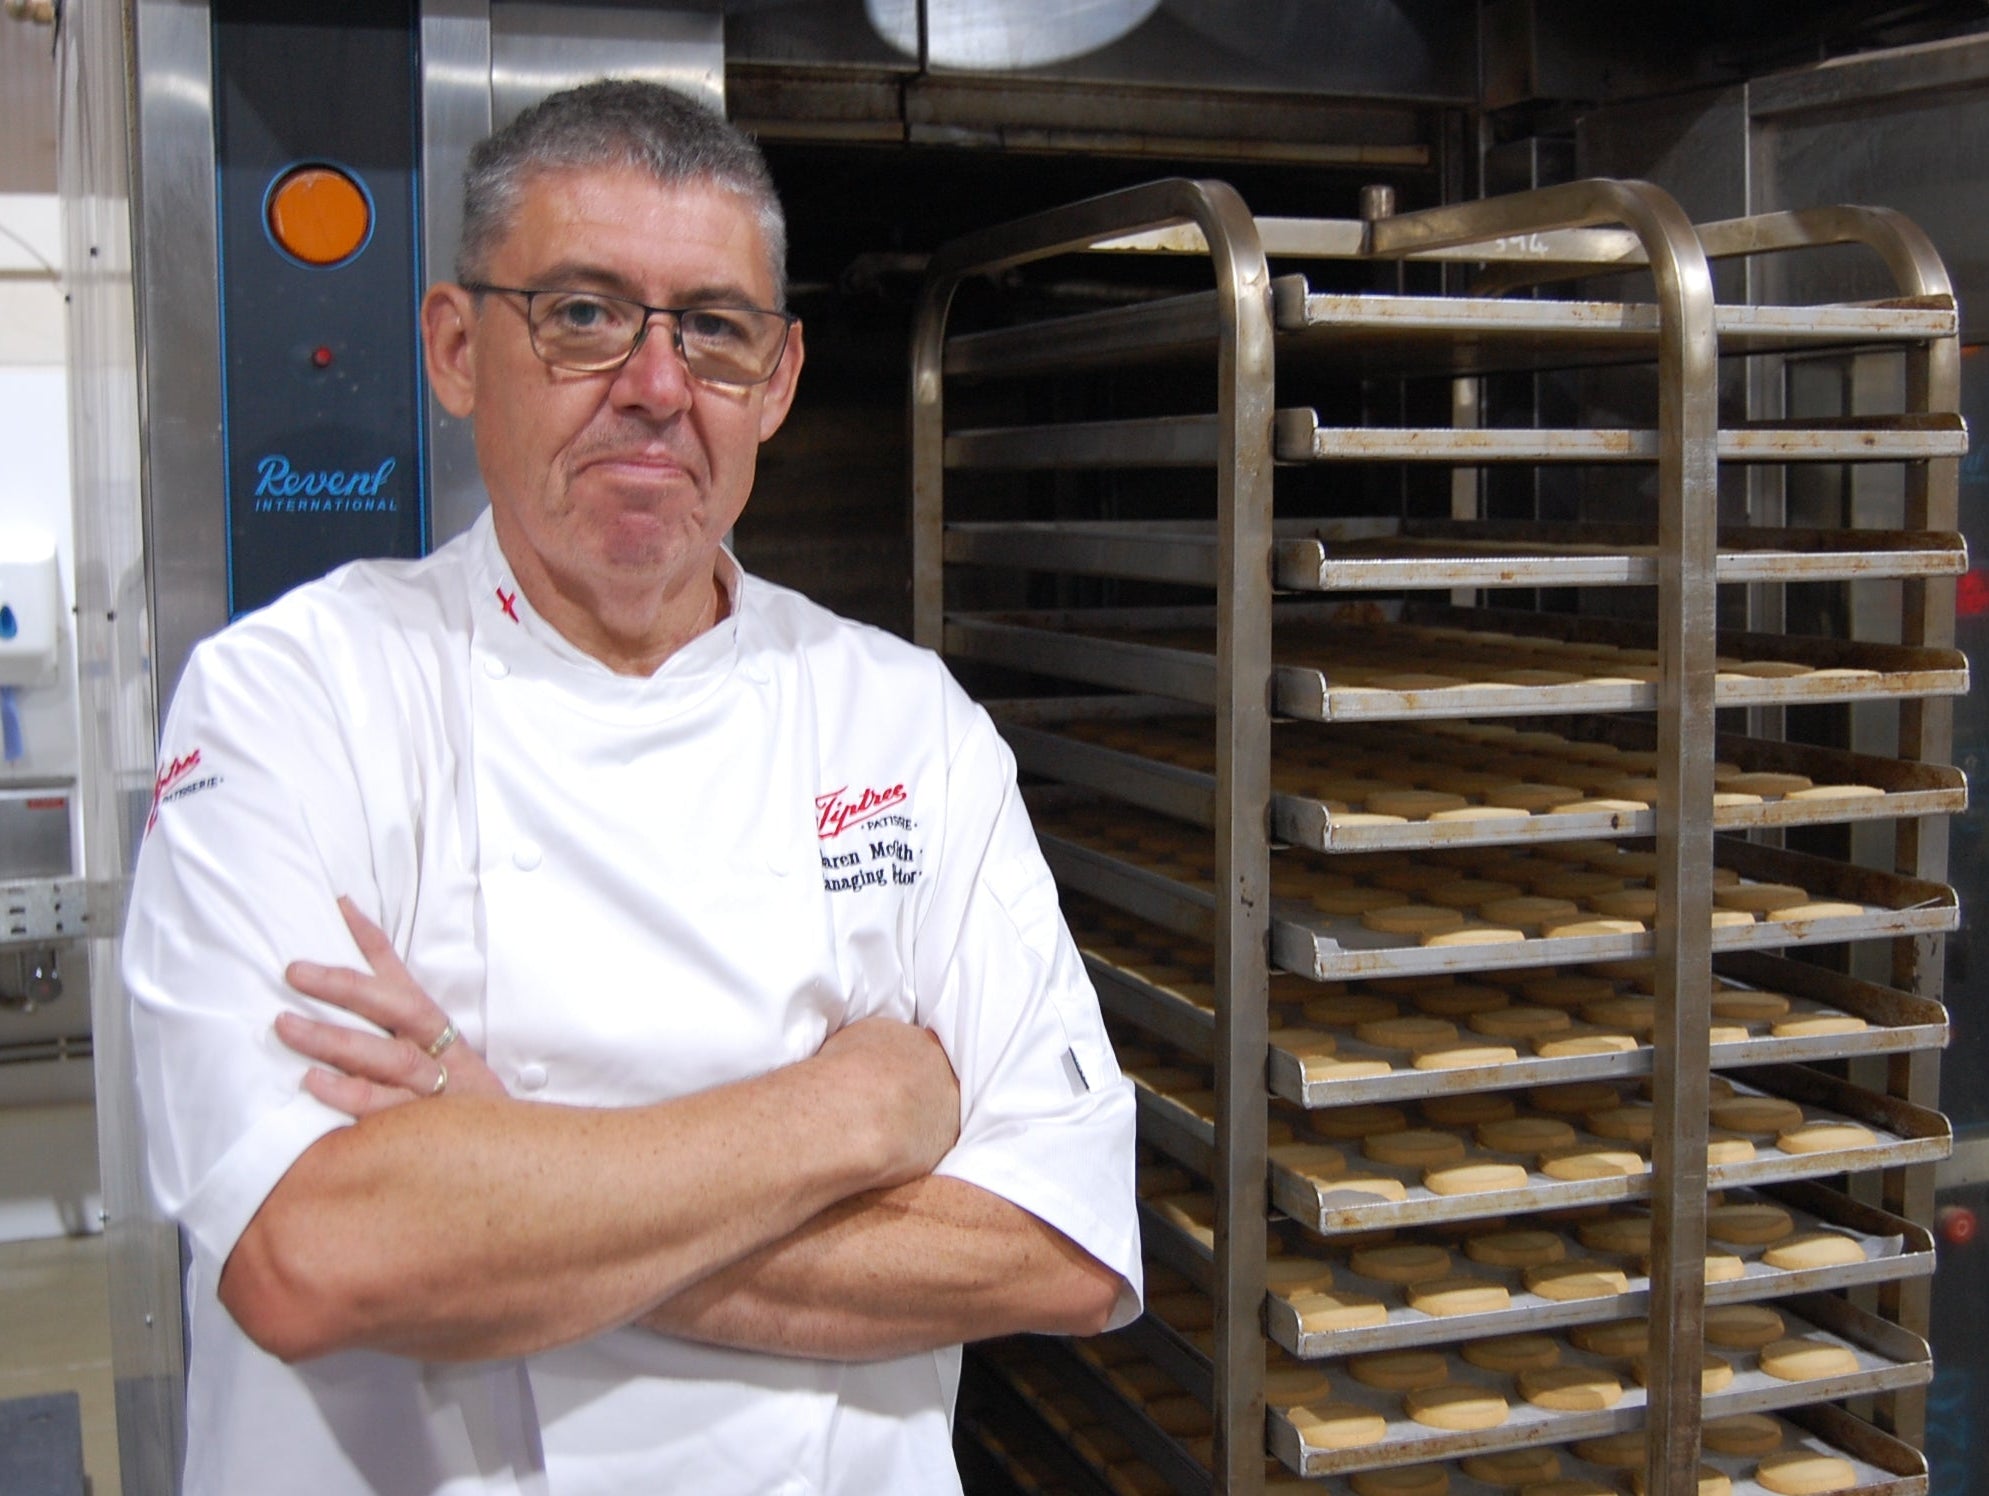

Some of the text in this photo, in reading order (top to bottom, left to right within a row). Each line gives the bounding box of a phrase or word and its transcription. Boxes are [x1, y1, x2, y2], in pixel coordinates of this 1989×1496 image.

[255, 454, 396, 497] Revent
[255, 498, 398, 513] INTERNATIONAL
[815, 783, 907, 839] Tiptree
